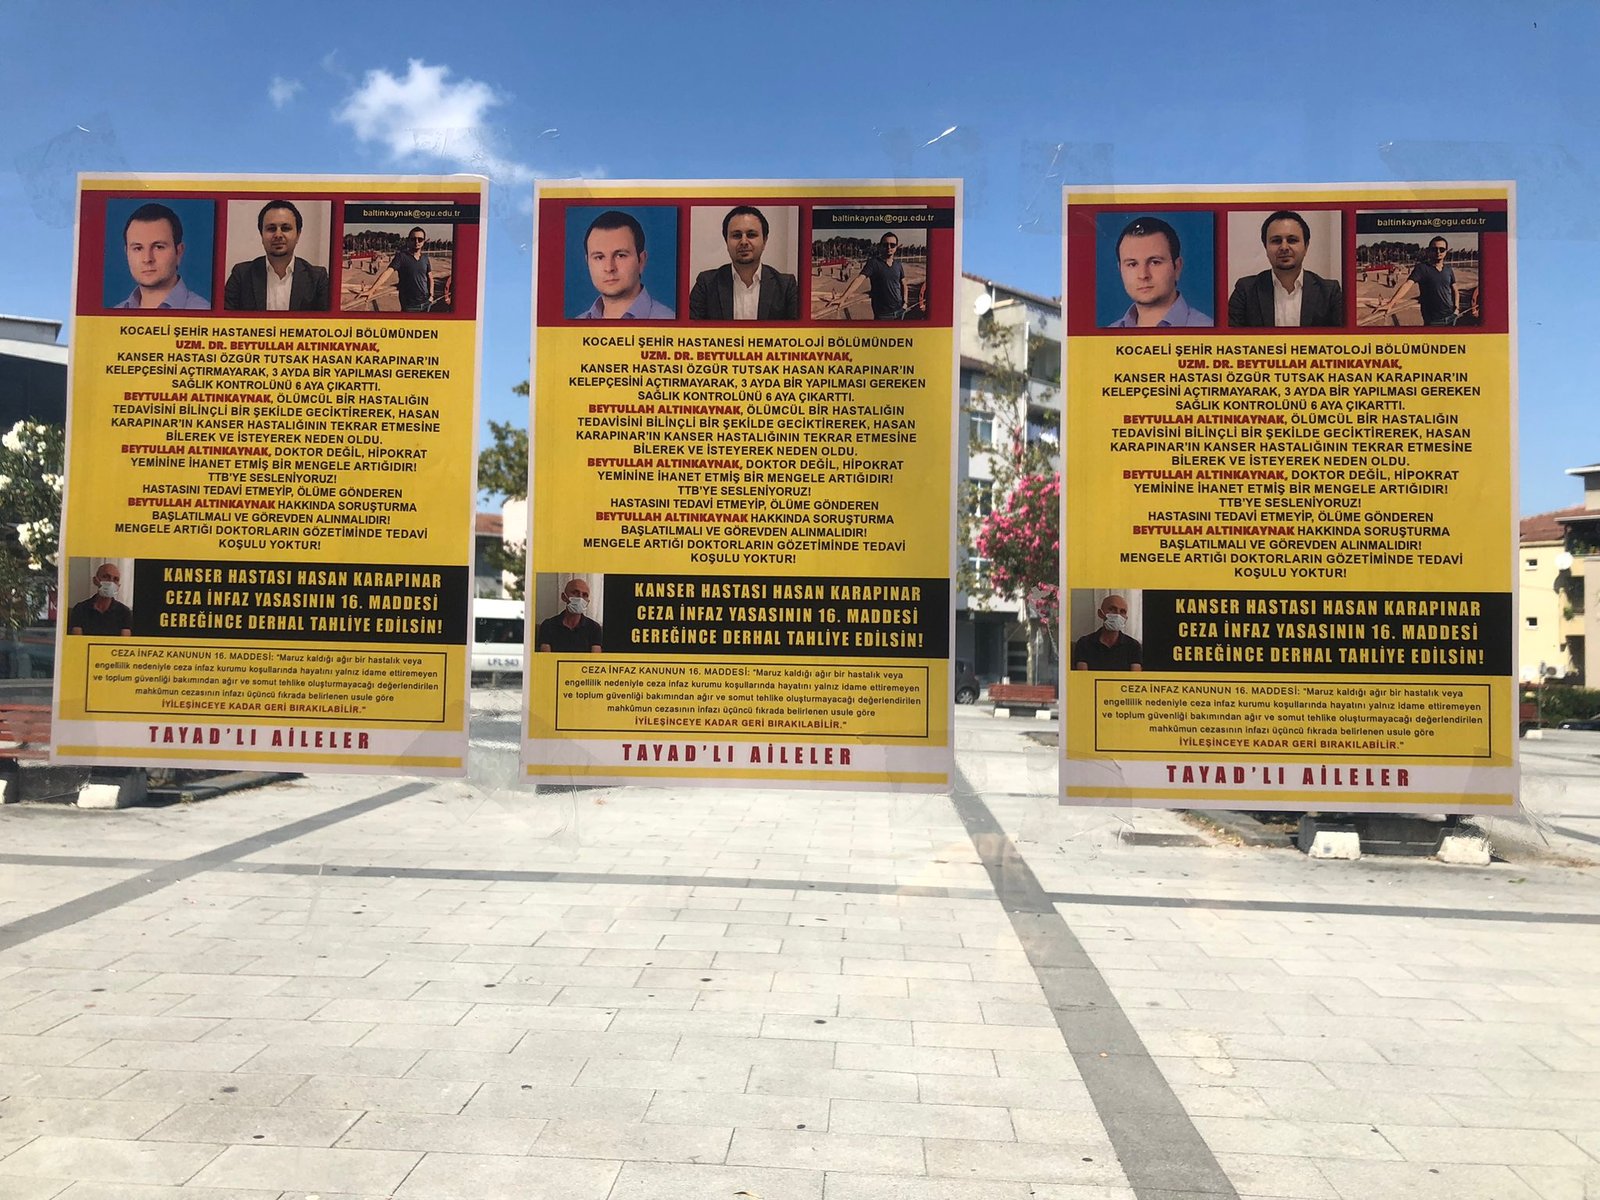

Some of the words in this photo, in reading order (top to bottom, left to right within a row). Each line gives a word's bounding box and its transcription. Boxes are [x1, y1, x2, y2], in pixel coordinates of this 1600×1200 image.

[362, 209, 461, 218] baltinkaynak@ogu.edu.tr
[832, 214, 935, 223] baltinkaynak@ogu.edu.tr
[1376, 217, 1487, 227] baltinkaynak@ogu.edu.tr
[119, 324, 170, 336] KOCAELİ
[173, 324, 208, 337] ŞEHİR
[211, 325, 276, 337] HASTANESİ
[279, 326, 352, 338] HEMATOLOJİ
[355, 327, 438, 339] BÖLÜMÜNDEN
[175, 339, 205, 350] UZM.
[208, 340, 227, 350] DR.
[229, 340, 294, 351] BEYTULLAH
[296, 341, 380, 353] ALTINKAYNAK,
[117, 352, 164, 362] KANSER
[167, 352, 217, 363] HASTASI
[219, 352, 260, 363] ÖZGÜR
[263, 354, 309, 364] TUTSAK
[312, 354, 352, 364] HASAN
[105, 363, 177, 376] KELEPÇESİNİ
[179, 366, 268, 378] AÇTIRMAYARAK,
[272, 367, 278, 376] 3
[279, 367, 310, 377] AYDA
[312, 365, 331, 377] BİR
[333, 367, 392, 378] YAPILMASI
[395, 368, 450, 379] GEREKEN
[171, 377, 213, 389] SAĞLIK
[215, 378, 292, 390] KONTROLÜNÜ
[295, 381, 302, 390] 6
[303, 380, 324, 390] AYA
[326, 381, 380, 392] ÇIKARTTI.
[588, 403, 654, 414] BEYTULLAH
[657, 404, 743, 416] ALTINKAYNAK,
[746, 403, 805, 415] ÖLÜMCÜL
[808, 403, 828, 415] BİR
[832, 404, 904, 415] HASTALIĞIN
[577, 415, 642, 427] TEDAVİSİNİ
[646, 415, 696, 430] BİLİNÇLİ
[699, 416, 719, 428] BİR
[722, 416, 774, 430] ŞEKİLDE
[776, 416, 870, 430] GECİKTİREREK,
[873, 419, 915, 429] HASAN
[663, 431, 713, 441] KANSER
[716, 430, 799, 442] HASTALIĞININ
[803, 432, 852, 442] TEKRAR
[856, 430, 916, 442] ETMESİNE
[633, 442, 685, 455] BİLEREK
[687, 445, 703, 455] VE
[706, 442, 773, 456] İSTEYEREK
[776, 445, 817, 456] NEDEN
[820, 446, 857, 456] OLDU.
[587, 457, 653, 468] BEYTULLAH
[655, 458, 743, 470] ALTINKAYNAK,
[746, 459, 796, 469] DOKTOR
[800, 457, 839, 471] DEĞİL,
[842, 457, 904, 470] HİPOKRAT
[597, 468, 654, 481] YEMİNİNE
[657, 469, 701, 482] İHANET
[704, 470, 740, 484] ETMİŞ
[743, 470, 764, 482] BİR
[767, 472, 825, 483] MENGELE
[828, 471, 893, 483] ARTIĞIDIR!
[1264, 495, 1361, 508] SESLENİYORUZ!
[1148, 510, 1211, 521] HASTASINI
[1214, 509, 1257, 521] TEDAVİ
[1260, 509, 1314, 523] ETMEYİP,
[1317, 510, 1361, 522] ÖLÜME
[1364, 510, 1433, 522] GÖNDEREN
[1132, 524, 1202, 535] BEYTULLAH
[1205, 525, 1295, 536] ALTINKAYNAK
[1297, 525, 1361, 536] HAKKINDA
[1363, 526, 1450, 538] SORUŞTURMA
[1160, 538, 1246, 551] BAŞLATILMALI
[1249, 539, 1265, 549] VE
[1269, 537, 1337, 550] GÖREVDEN
[1339, 539, 1421, 550] ALINMALIDIR!
[1120, 552, 1181, 563] MENGELE
[1183, 551, 1226, 563] ARTIĞI
[1230, 553, 1322, 564] DOKTORLARIN
[1326, 551, 1413, 564] GÖZETİMİNDE
[1416, 552, 1462, 564] TEDAVİ
[163, 567, 222, 583] KANSER
[228, 568, 291, 584] HASTASI
[297, 570, 347, 586] HASAN
[353, 571, 441, 588] KARAPINAR
[1234, 567, 1286, 579] KOŞULU
[1289, 567, 1346, 578] YOKTUR!
[634, 582, 694, 598] KANSER
[701, 583, 766, 599] HASTASI
[772, 584, 824, 600] HASAN
[830, 585, 920, 601] KARAPINAR
[165, 589, 201, 605] CEZA
[207, 588, 249, 606] İNFAZ
[254, 592, 335, 608] YASASININ
[340, 594, 362, 609] 16.
[368, 593, 438, 611] MADDESİ
[1175, 598, 1239, 614] KANSER
[1246, 598, 1316, 615] HASTASI
[1322, 599, 1377, 615] HASAN
[1384, 600, 1480, 616] KARAPINAR
[637, 605, 674, 620] CEZA
[679, 603, 723, 621] İNFAZ
[728, 606, 812, 622] YASASININ
[818, 607, 840, 623] 16.
[846, 606, 918, 624] MADDESİ
[159, 610, 242, 629] GEREĞİNCE
[248, 614, 304, 630] DERHAL
[309, 614, 370, 632] TAHLİYE
[376, 615, 442, 634] EDİLSİN!
[631, 625, 716, 644] GEREĞİNCE
[722, 629, 781, 645] DERHAL
[786, 628, 849, 646] TAHLİYE
[855, 629, 923, 647] EDİLSİN!
[1178, 621, 1218, 637] CEZA
[1224, 620, 1270, 638] İNFAZ
[1276, 622, 1365, 639] YASASININ
[1371, 624, 1395, 639] 16.
[1402, 622, 1477, 640] MADDESİ
[1172, 643, 1264, 662] GEREĞİNCE
[1270, 646, 1332, 663] DERHAL
[1338, 645, 1405, 663] TAHLİYE
[1411, 645, 1483, 664] EDİLSİN!
[271, 726, 369, 749] AİLELER
[749, 742, 850, 765] AİLELER
[1302, 764, 1408, 786] AİLELER
